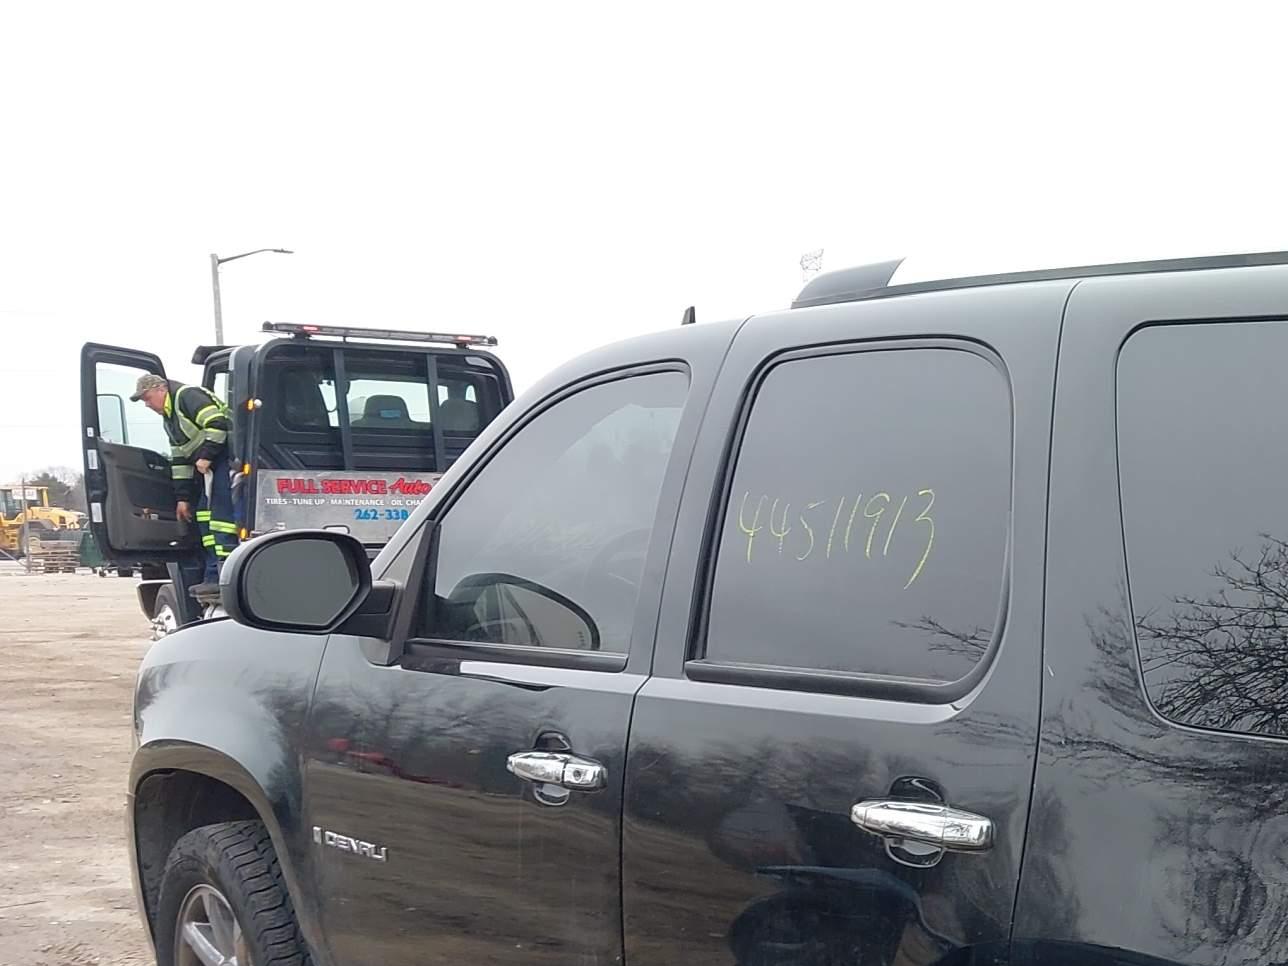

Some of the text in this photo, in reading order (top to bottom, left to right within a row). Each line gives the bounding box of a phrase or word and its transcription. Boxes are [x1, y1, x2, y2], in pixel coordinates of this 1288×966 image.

[276, 477, 432, 495] FULL SERVICE Auto
[314, 498, 325, 506] UP
[739, 488, 936, 590] 44511913
[324, 830, 387, 862] DENALI
